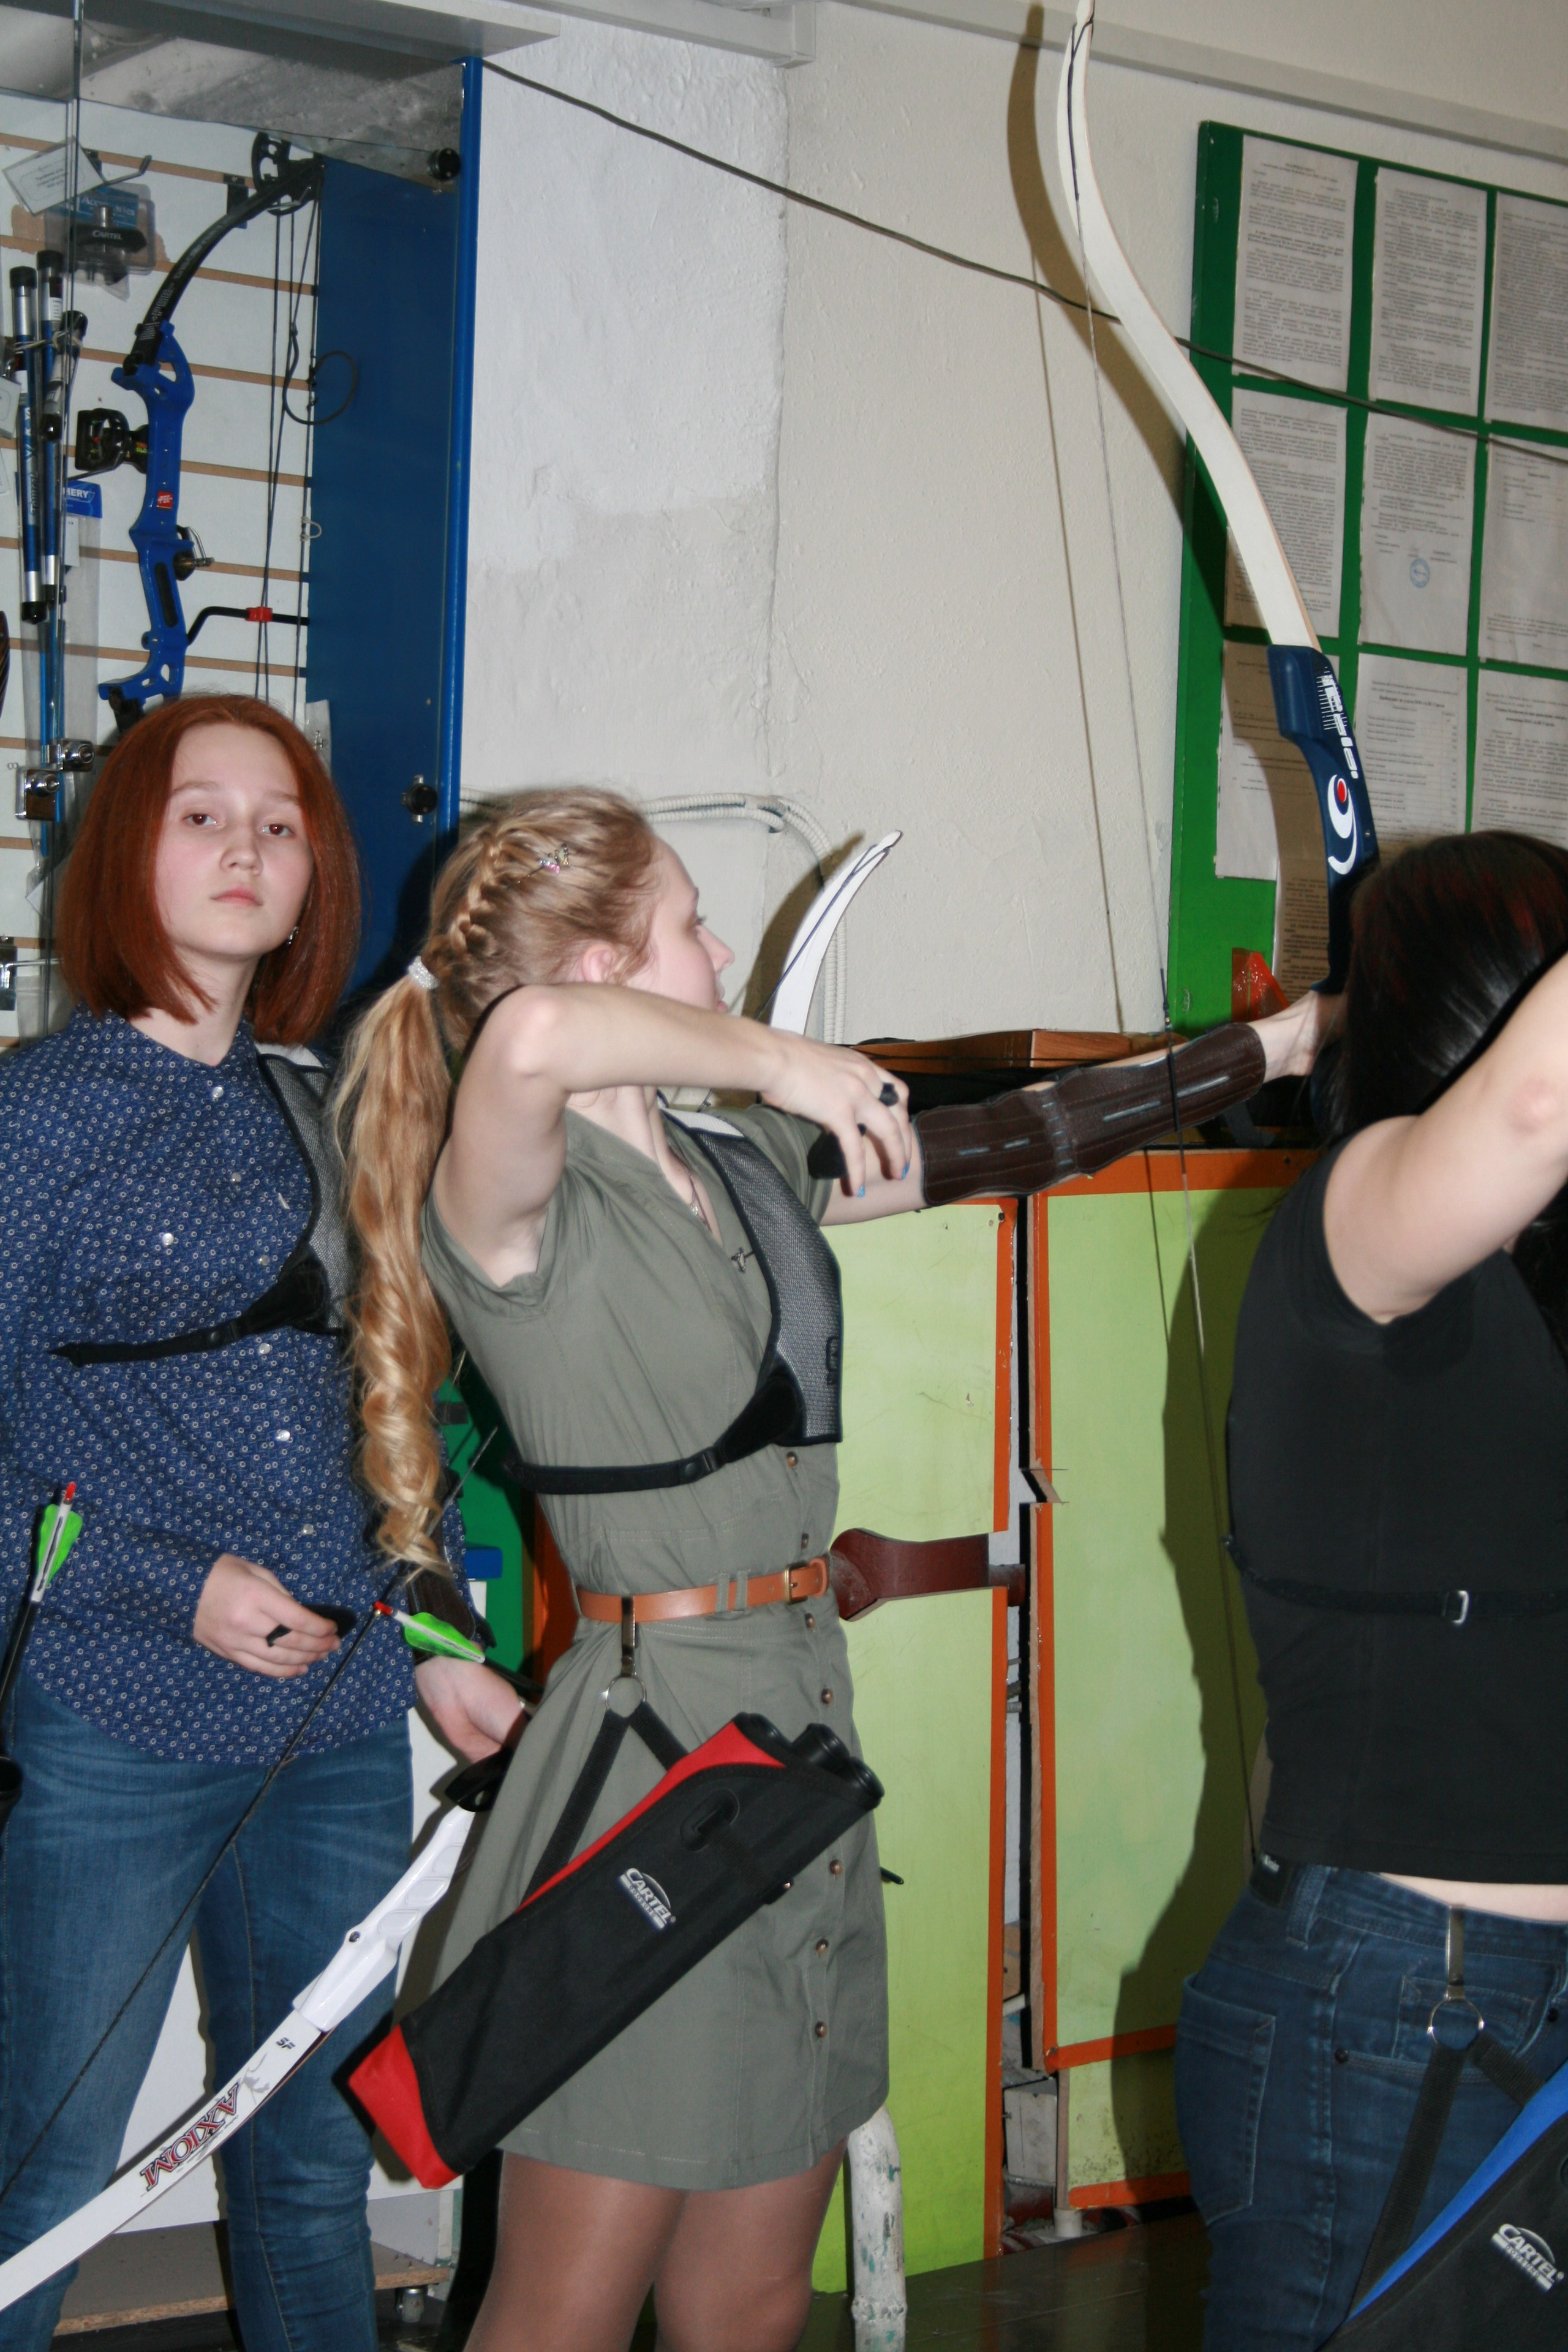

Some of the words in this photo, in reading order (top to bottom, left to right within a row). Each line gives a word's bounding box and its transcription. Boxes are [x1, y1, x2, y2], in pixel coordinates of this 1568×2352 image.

[92, 230, 123, 240] CARTEL
[627, 1868, 671, 1924] CARTEL
[276, 2037, 296, 2050] SF
[140, 2082, 239, 2191] AXIOM
[1498, 2223, 1558, 2283] CARTEL
